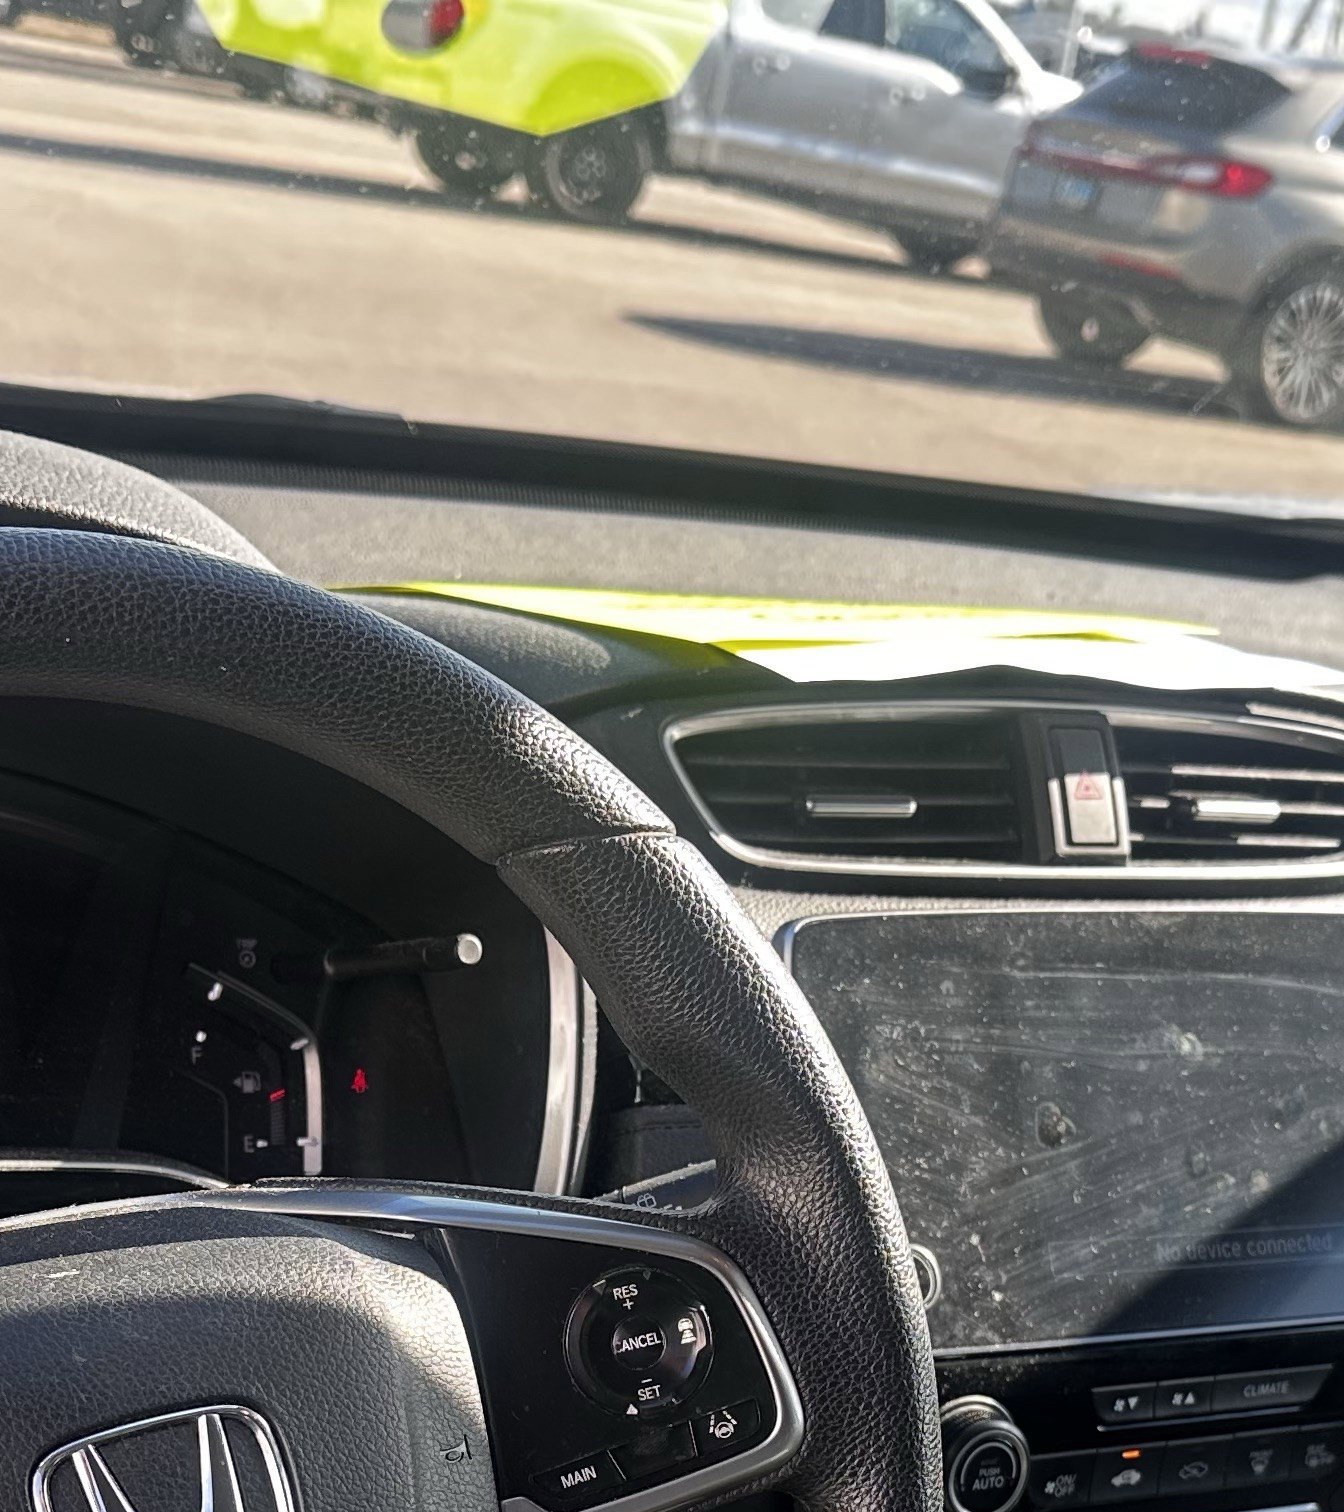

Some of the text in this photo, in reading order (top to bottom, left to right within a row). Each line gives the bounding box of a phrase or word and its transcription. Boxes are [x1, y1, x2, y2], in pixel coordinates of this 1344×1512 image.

[191, 1046, 203, 1064] F
[243, 1135, 255, 1154] E
[1186, 1242, 1240, 1260] device
[1248, 1233, 1332, 1257] connected
[613, 1283, 638, 1301] RES
[613, 1332, 662, 1354] CANCEL
[637, 1384, 661, 1401] SET
[1243, 1380, 1291, 1398] CLIMATE
[560, 1466, 597, 1489] MAIN
[972, 1476, 1004, 1492] AUTO
